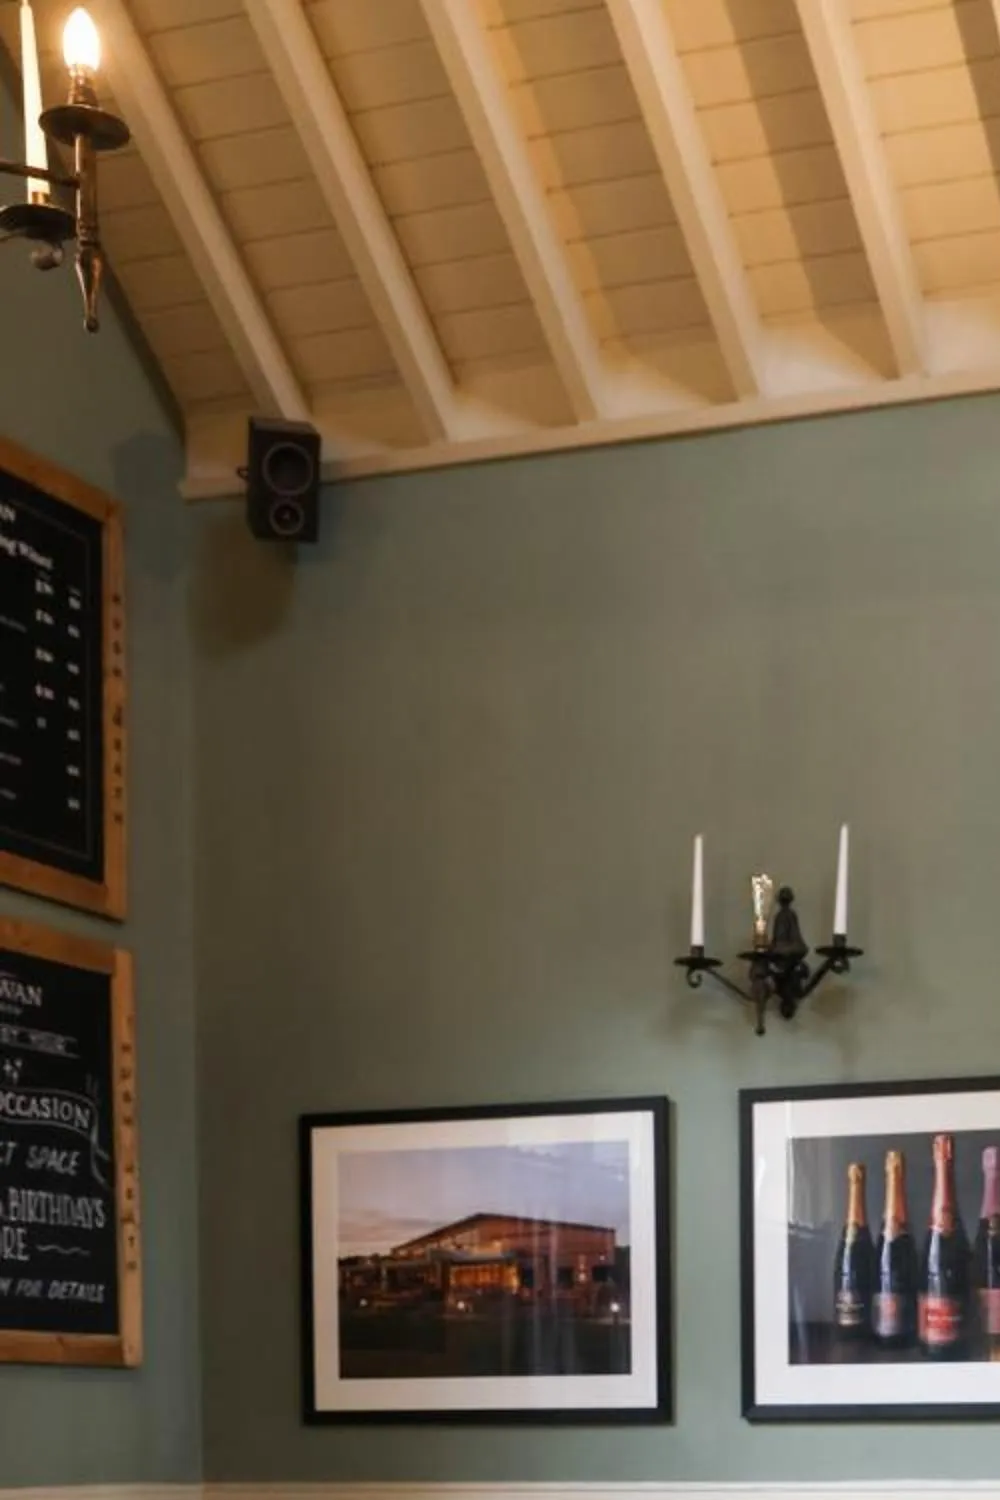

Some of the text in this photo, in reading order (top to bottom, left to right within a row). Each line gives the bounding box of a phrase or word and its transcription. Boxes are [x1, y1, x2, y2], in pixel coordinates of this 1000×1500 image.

[24, 1144, 80, 1176] SPACE
[8, 1186, 106, 1230] BIRTHDAYS
[0, 1225, 30, 1262] RE
